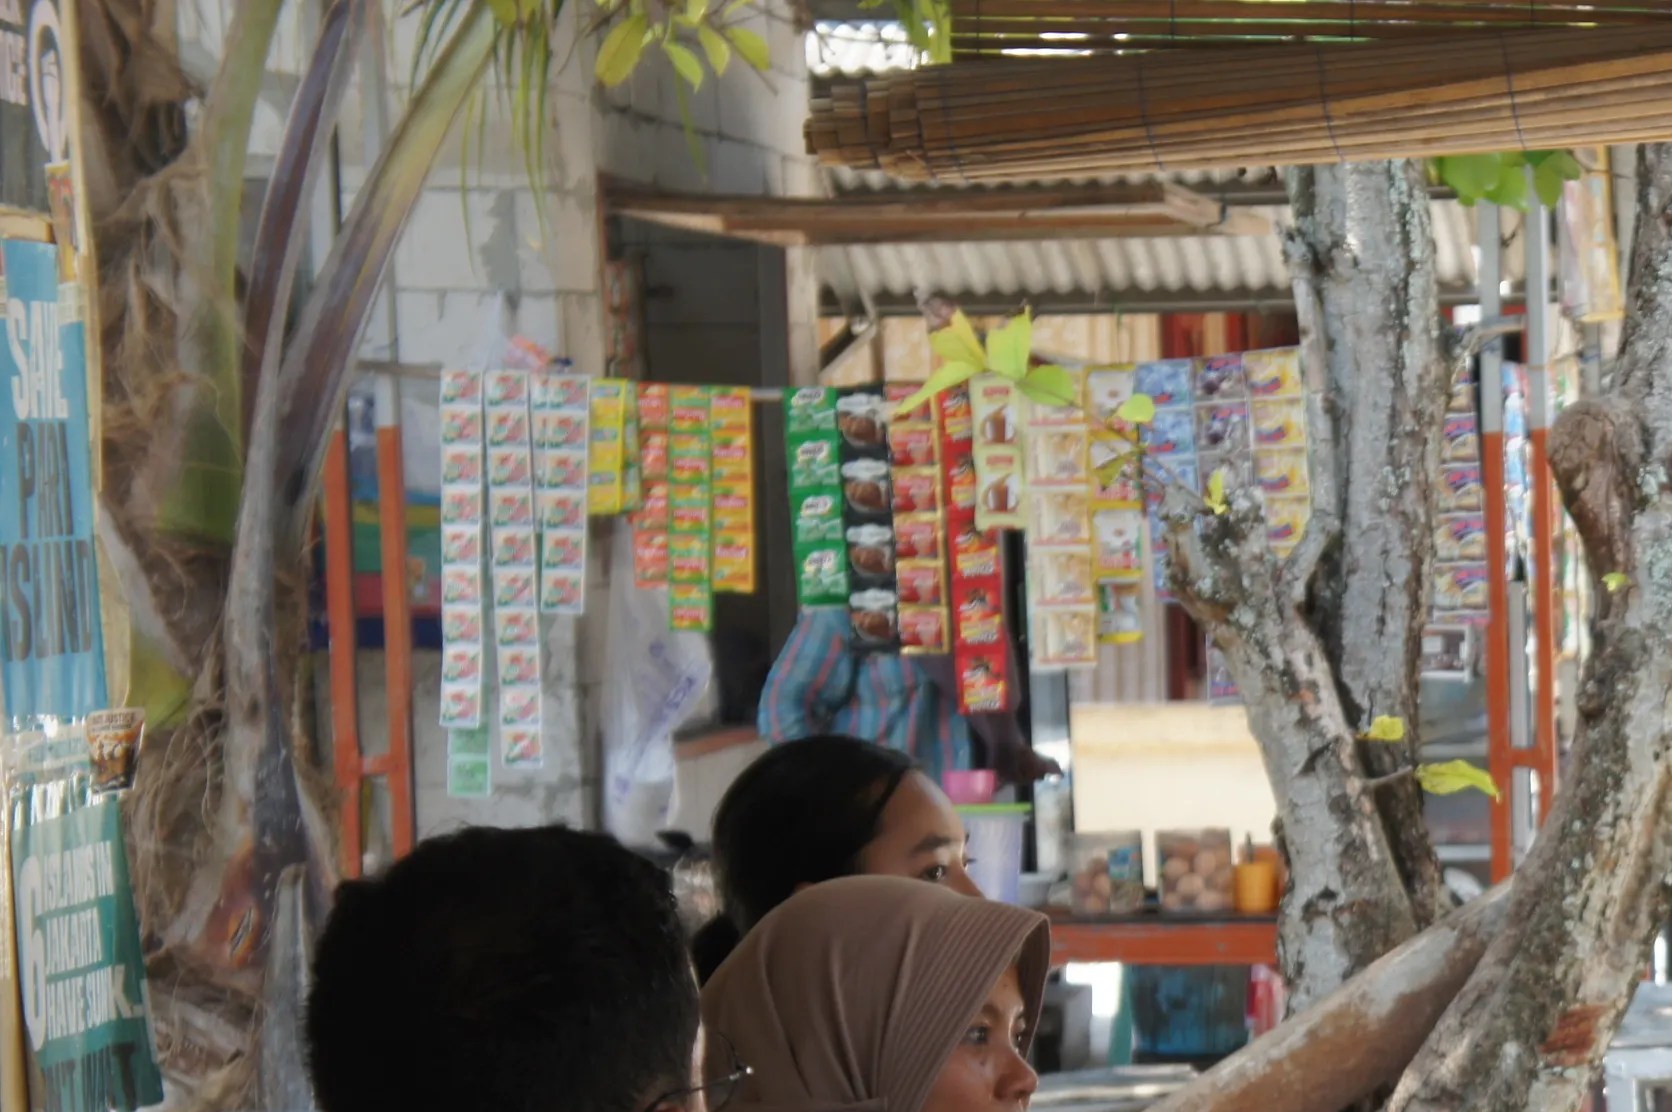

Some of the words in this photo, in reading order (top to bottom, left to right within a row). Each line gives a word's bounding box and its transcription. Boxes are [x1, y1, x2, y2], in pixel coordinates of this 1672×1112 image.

[5, 299, 69, 419] SAVE
[16, 421, 74, 540] PARI
[97, 839, 114, 896] IN
[19, 855, 47, 1051] 6
[46, 905, 102, 975] JAKARTA
[46, 974, 85, 1041] HAVE
